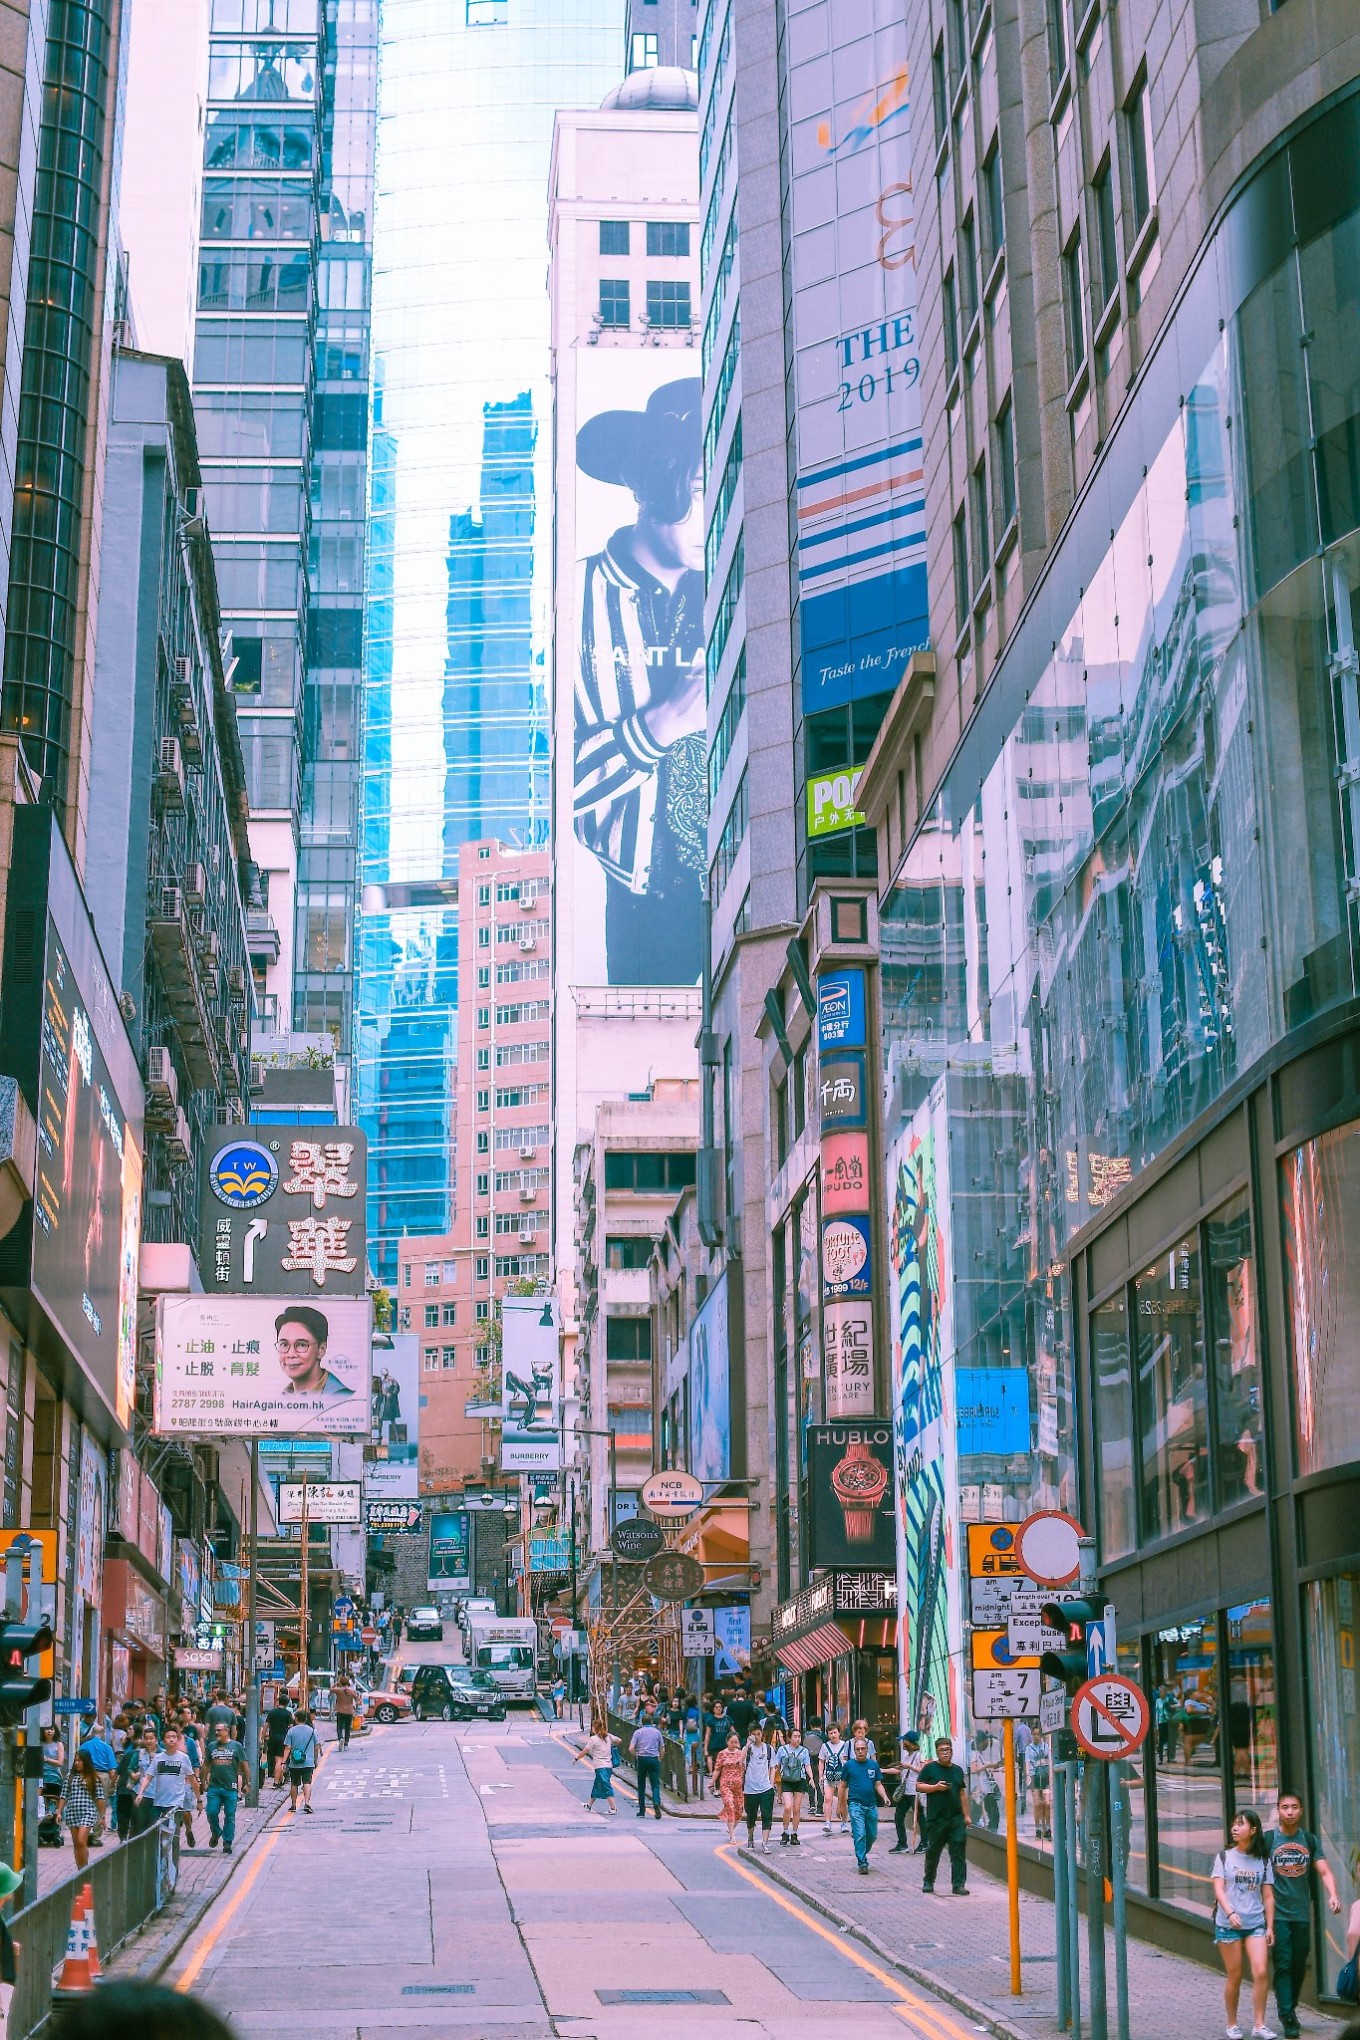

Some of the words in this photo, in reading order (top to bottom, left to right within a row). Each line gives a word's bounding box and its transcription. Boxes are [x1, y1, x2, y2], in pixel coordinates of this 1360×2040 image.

[835, 314, 914, 369] THE
[837, 357, 920, 413] 2019
[592, 646, 668, 667] ANT
[820, 662, 856, 686] Taste
[860, 650, 882, 671] the
[814, 808, 865, 830] 户外无
[821, 1020, 850, 1033] 中環分行
[825, 1155, 863, 1180] 一風堂
[281, 1139, 359, 1287] 翠華
[214, 1217, 232, 1283] 威靈頓街
[826, 1245, 851, 1262] FOOT
[831, 1283, 848, 1294] 1999
[849, 1278, 869, 1291] 12/F
[185, 1338, 215, 1354] 止油
[230, 1361, 260, 1377] 育髮
[826, 1349, 870, 1380] 廣場
[828, 1382, 871, 1396] ENURY
[171, 1399, 196, 1409] 2787
[199, 1399, 225, 1409] 2998
[232, 1399, 325, 1412] HairAgain.com.hk
[816, 1430, 893, 1445] HUBLO
[510, 1452, 549, 1460] BURBERRY
[660, 1481, 683, 1489] NCB
[617, 1530, 659, 1539] Watson's
[617, 1540, 642, 1550] Wine
[982, 1587, 1002, 1596] 上午
[1013, 1579, 1024, 1592] 7
[1014, 1593, 1036, 1601] Length
[975, 1603, 1010, 1612] midnight
[984, 1613, 1003, 1622] 午夜
[1013, 1618, 1043, 1628] Excep
[702, 1635, 708, 1643] 7
[263, 1647, 269, 1656] 7
[703, 1647, 713, 1655] 12
[1015, 1640, 1067, 1652] 專利巴士
[264, 1660, 273, 1668] 12
[987, 1680, 1007, 1689] 上午
[1017, 1672, 1028, 1689] 7
[987, 1704, 1008, 1715] 下午
[1017, 1697, 1029, 1713] 7
